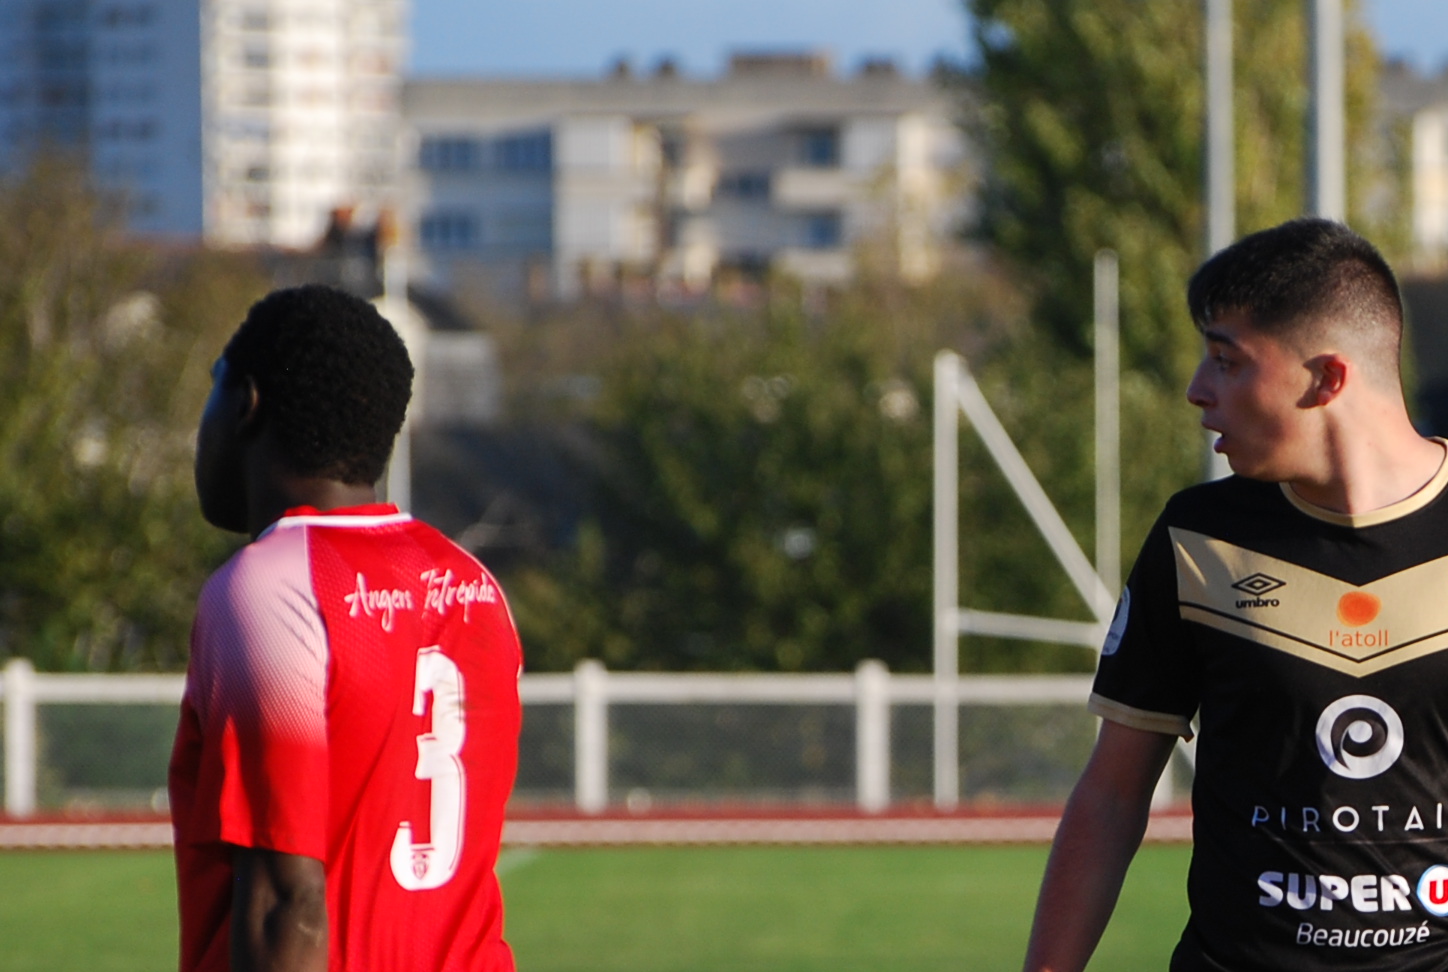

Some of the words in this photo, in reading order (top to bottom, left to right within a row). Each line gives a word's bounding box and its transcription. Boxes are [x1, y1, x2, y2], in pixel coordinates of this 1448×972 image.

[1236, 597, 1280, 609] umbro
[1328, 629, 1389, 647] l'atoll
[390, 645, 466, 891] 3
[1257, 871, 1412, 912] SUPER
[1296, 919, 1430, 948] Beaucouzé
